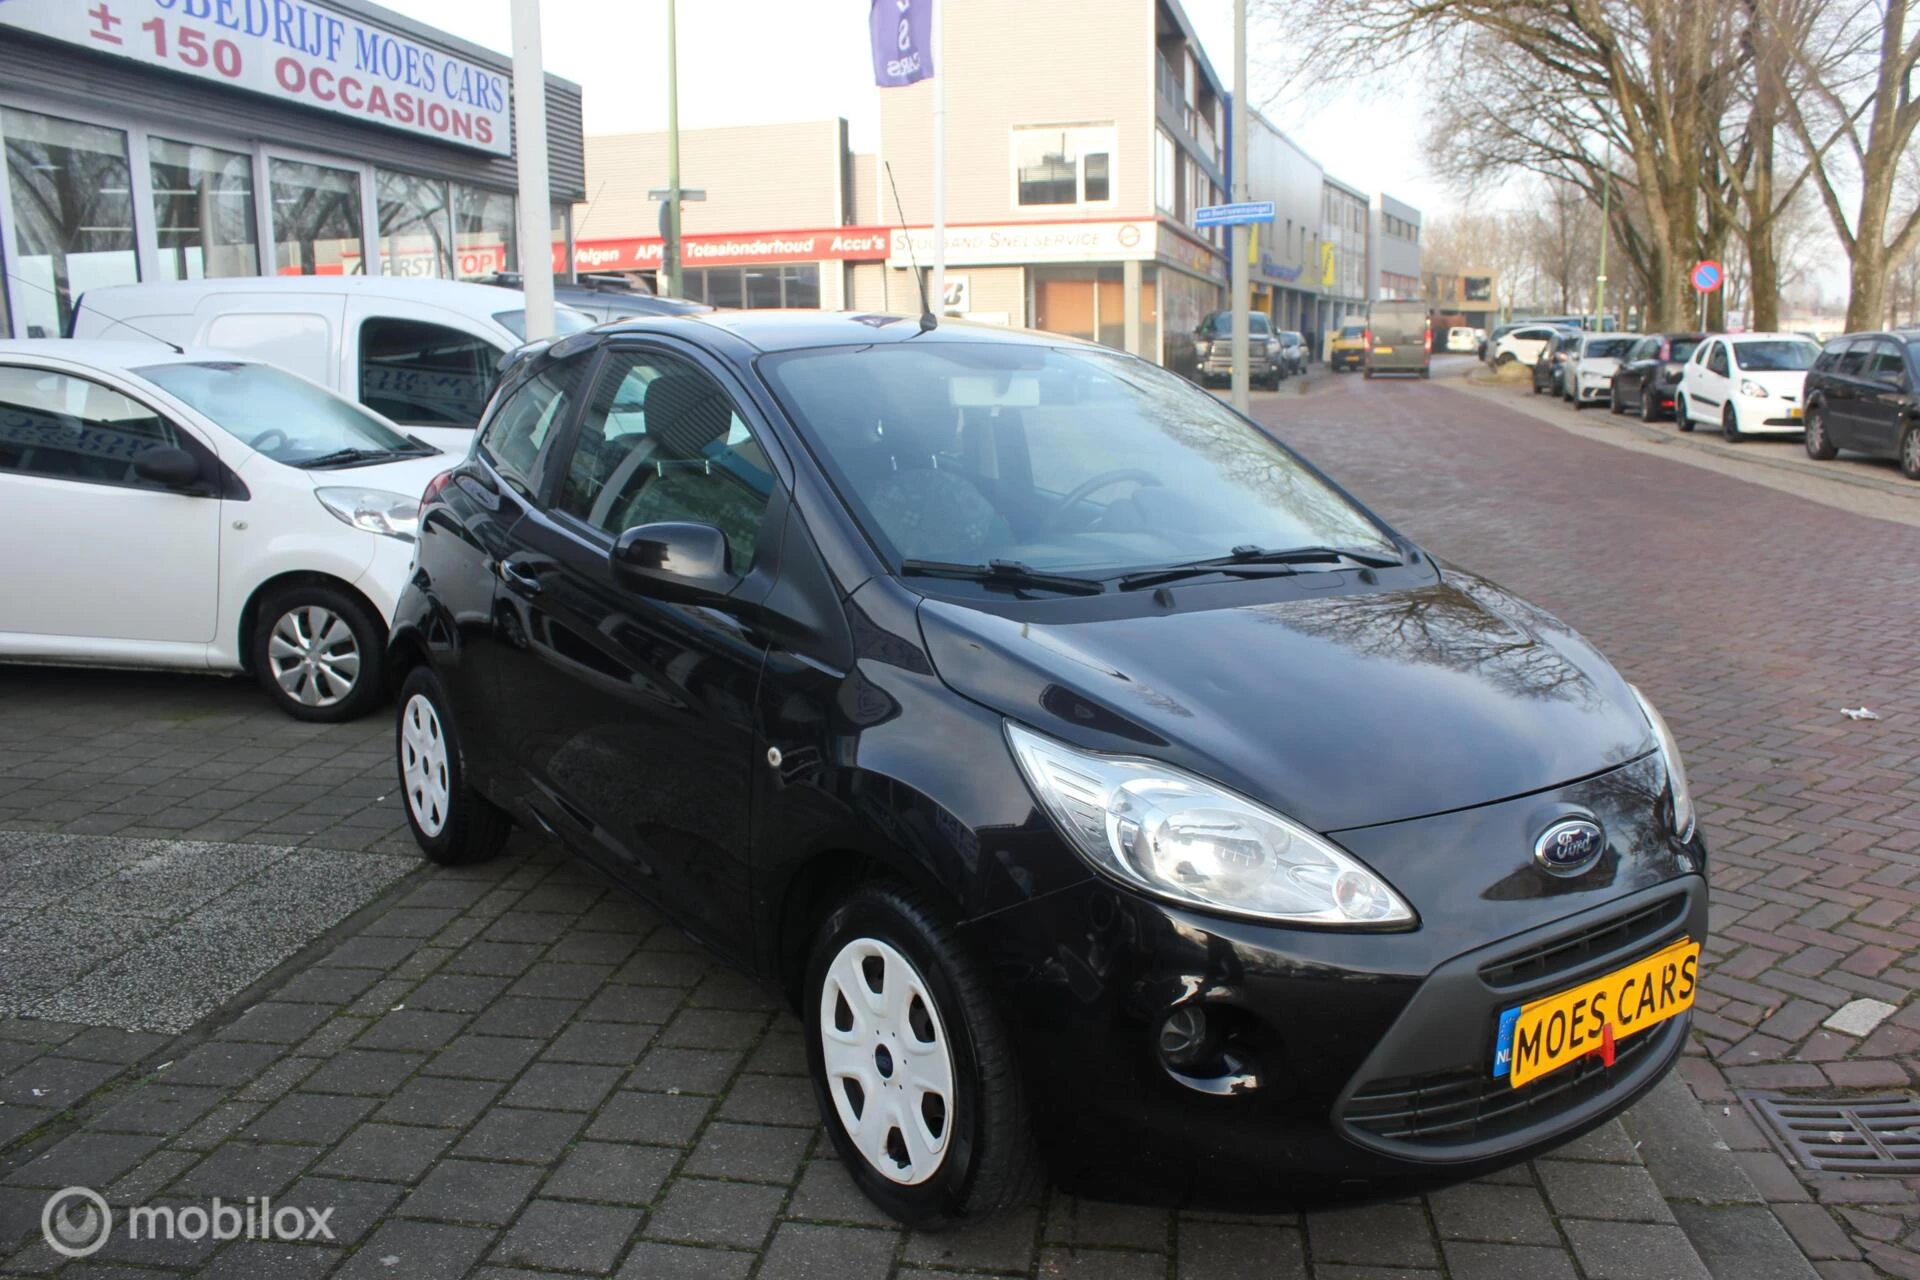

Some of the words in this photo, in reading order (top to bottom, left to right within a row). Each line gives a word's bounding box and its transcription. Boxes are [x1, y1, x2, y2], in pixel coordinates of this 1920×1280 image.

[141, 16, 243, 78] 150
[275, 57, 494, 145] OCCASIONS
[155, 0, 344, 62] EDRIJF
[355, 27, 436, 92] MOES
[443, 61, 504, 114] CARS
[687, 238, 814, 258] Totaalonderhoud
[830, 234, 885, 252] Accu's
[1556, 828, 1592, 859] Ford
[1515, 991, 1608, 1074] MOES
[1616, 954, 1698, 1026] CARS
